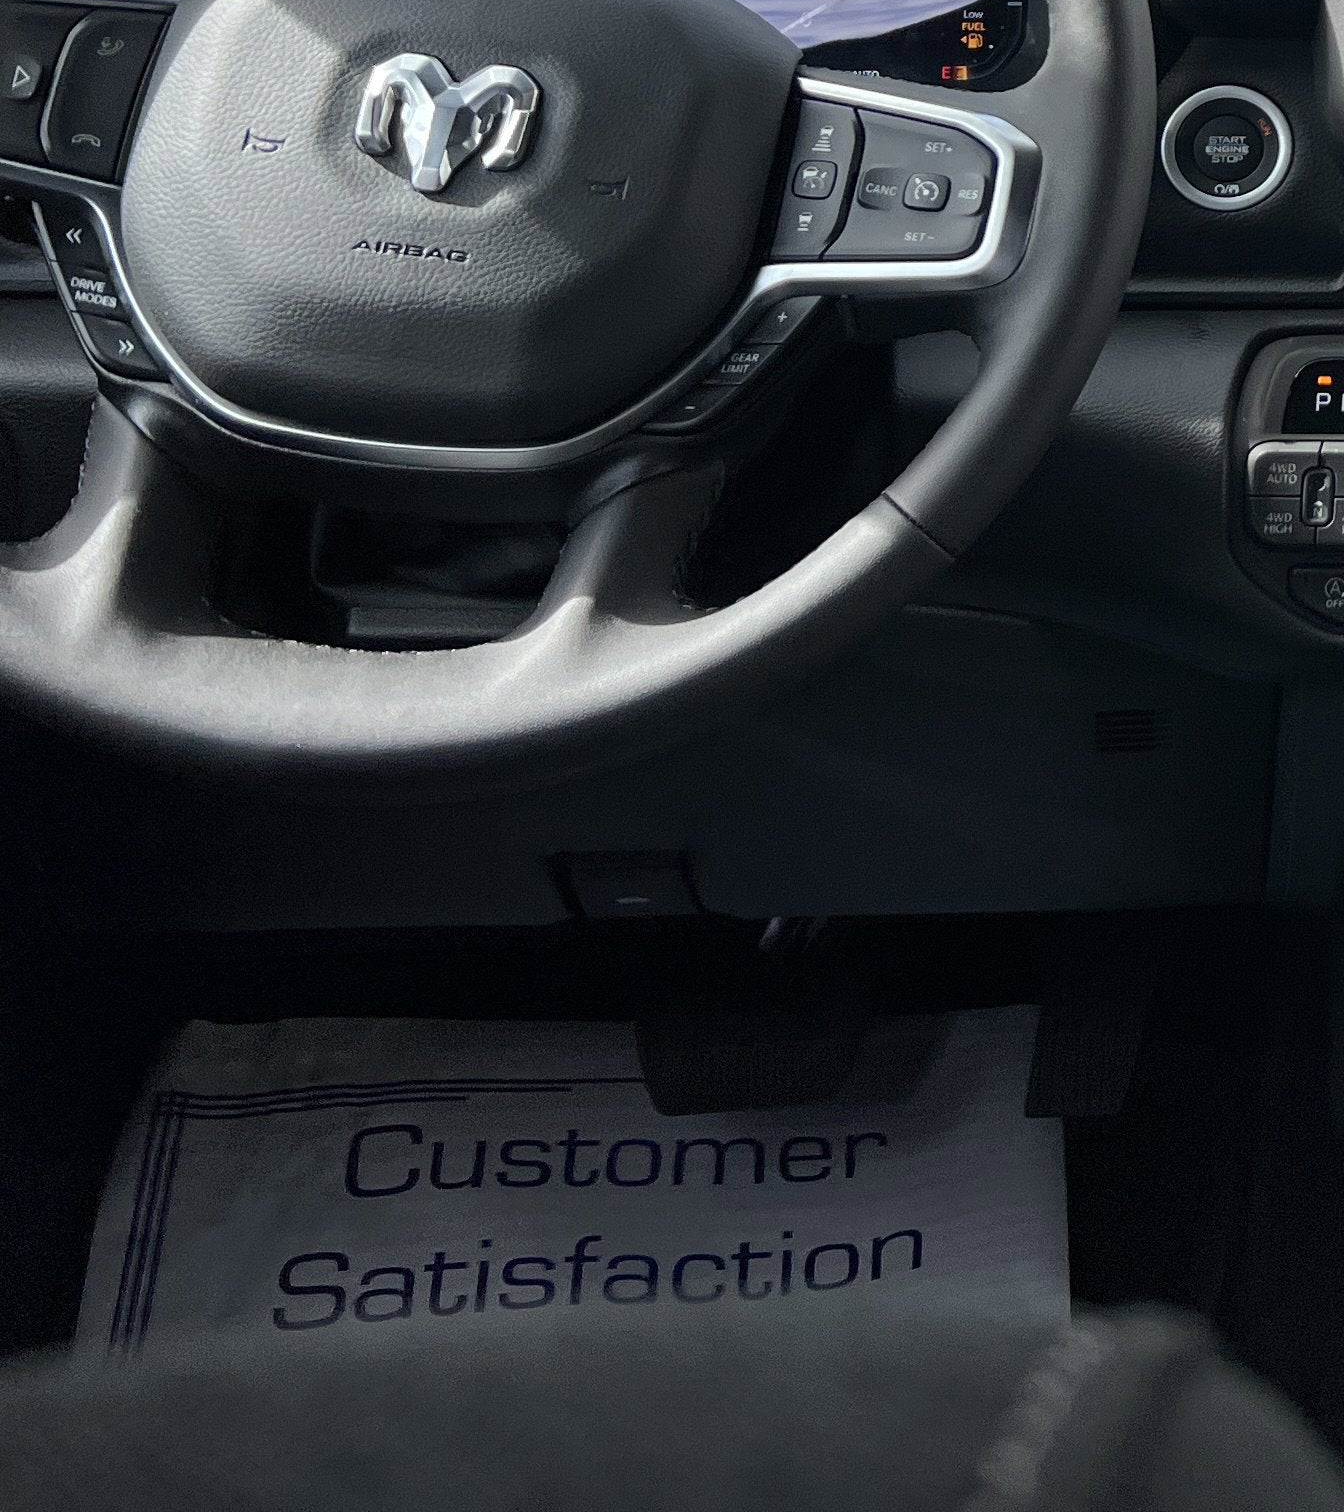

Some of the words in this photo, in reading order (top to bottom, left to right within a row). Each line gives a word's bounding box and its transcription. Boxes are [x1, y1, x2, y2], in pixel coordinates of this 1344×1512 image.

[963, 10, 983, 19] Low
[962, 22, 985, 31] FUEL
[941, 67, 951, 79] E
[1208, 135, 1247, 145] START
[925, 142, 953, 153] SET+
[1205, 145, 1250, 155] ENGINE
[1211, 154, 1244, 163] STOP
[865, 183, 898, 196] CANC
[958, 190, 979, 200] RES
[352, 240, 471, 263] AIRBAG
[71, 276, 106, 293] DRIVE
[75, 290, 117, 309] MODES
[731, 353, 760, 362] GEAR
[721, 364, 750, 374] LIMIT
[1315, 392, 1331, 412] P
[1268, 462, 1297, 473] 4WD
[1266, 474, 1298, 485] AUTO
[1266, 512, 1292, 522] 4WD
[1263, 523, 1293, 534] HIGH
[1326, 599, 1344, 608] OFF
[343, 1124, 889, 1198] Customer
[272, 1228, 925, 1332] Satisfaction
